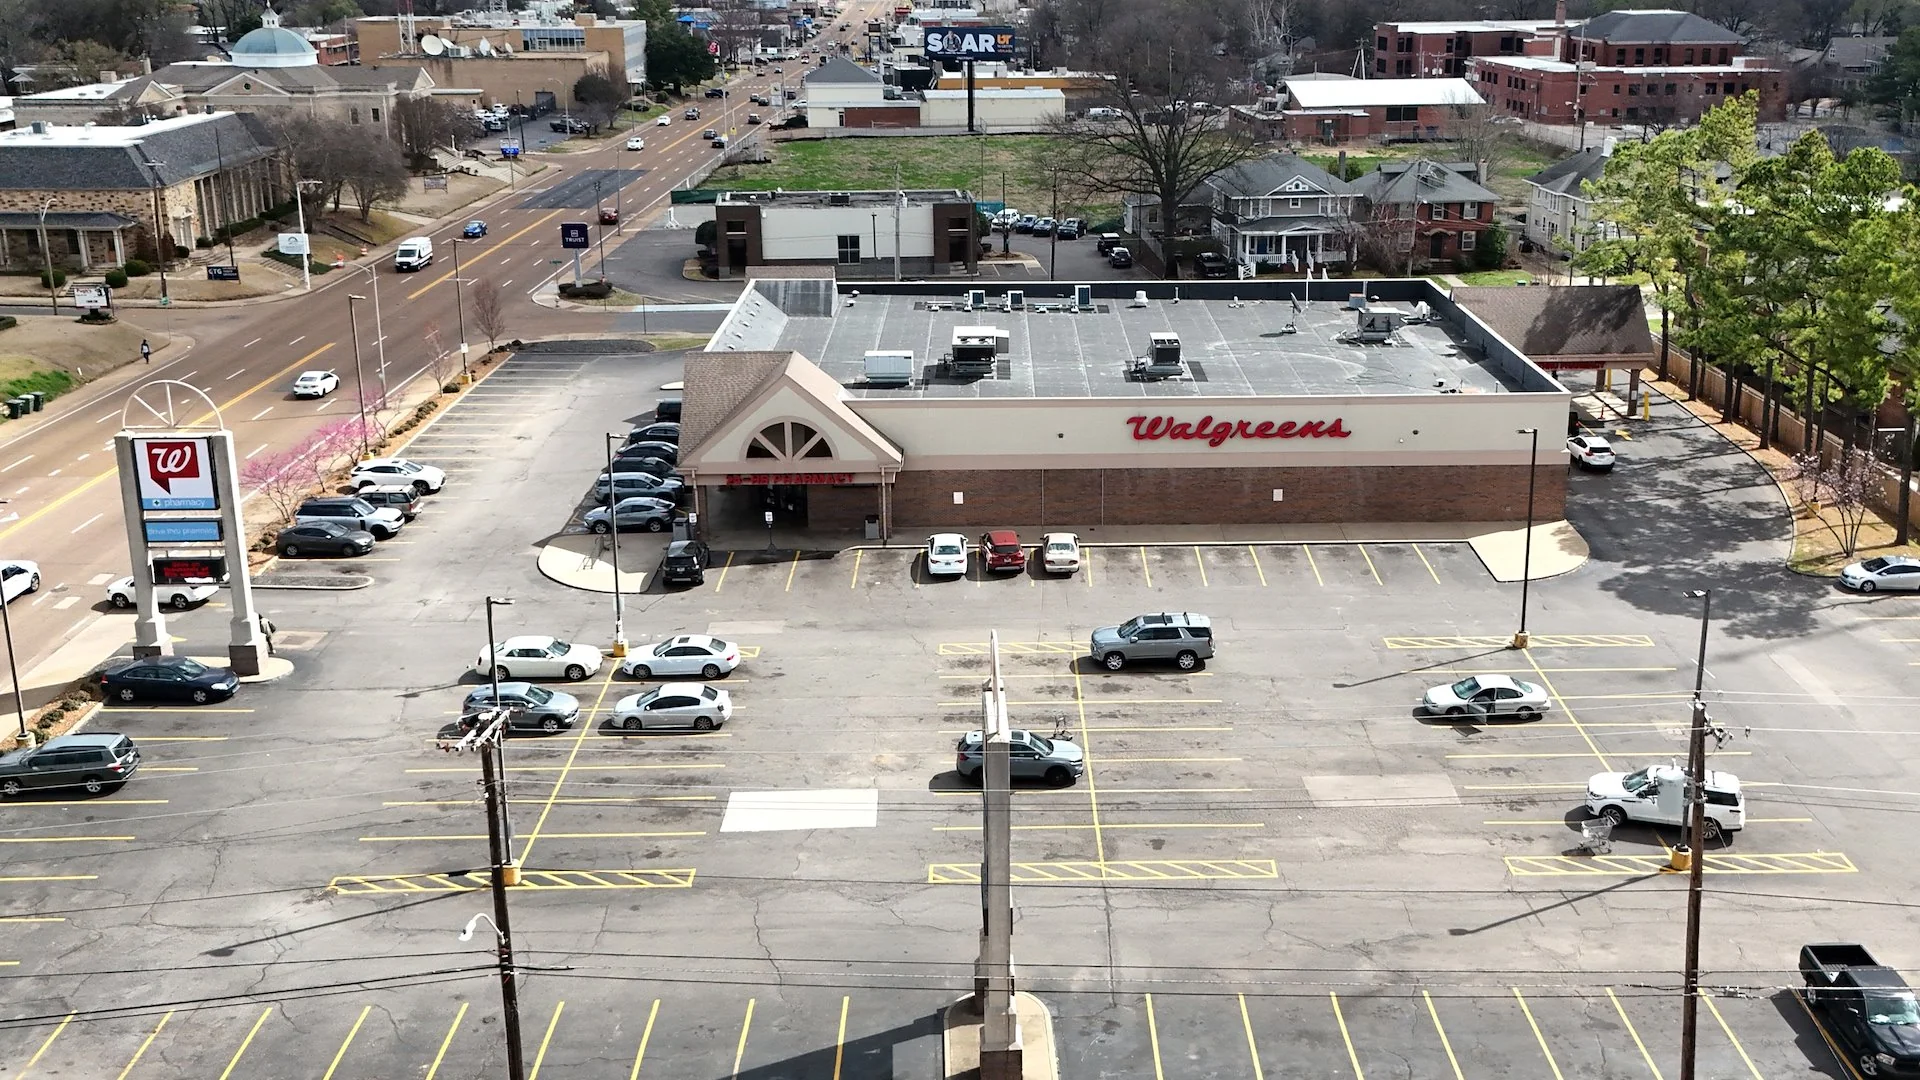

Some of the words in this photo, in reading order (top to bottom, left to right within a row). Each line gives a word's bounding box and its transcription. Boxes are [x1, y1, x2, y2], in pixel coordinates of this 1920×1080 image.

[927, 32, 995, 52] SOAR
[1126, 415, 1351, 447] Walgreens
[773, 473, 854, 485] PHARMACY
[164, 499, 206, 507] pharmacy
[182, 527, 218, 536] pharmacy
